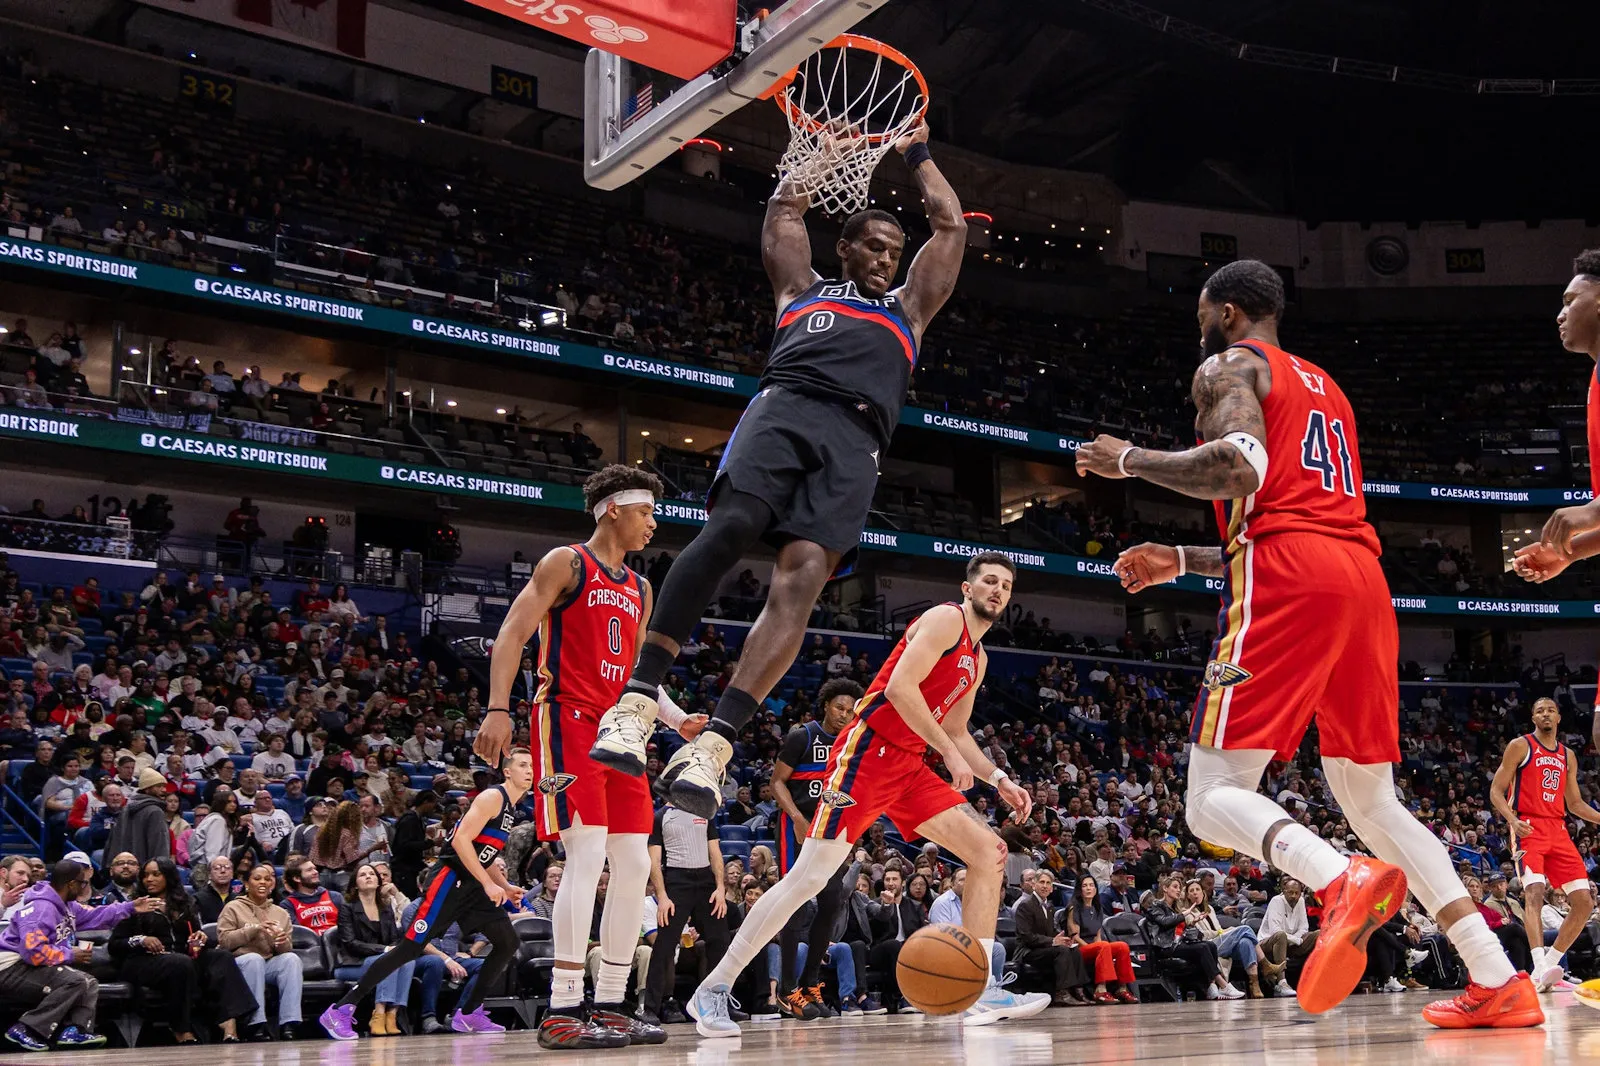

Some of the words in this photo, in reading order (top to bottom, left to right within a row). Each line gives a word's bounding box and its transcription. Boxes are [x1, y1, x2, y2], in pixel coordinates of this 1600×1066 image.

[182, 75, 233, 106] 332
[496, 72, 532, 99] 301
[160, 203, 185, 219] 331
[47, 250, 138, 280] SPORTSBOOK
[1450, 252, 1482, 268] 304
[210, 281, 283, 306] CAESARS
[284, 295, 364, 322] SPORTSBOOK
[807, 310, 835, 333] 0
[426, 321, 489, 344] CAESARS
[491, 333, 561, 357] SPORTSBOOK
[615, 356, 672, 378] CAESARS
[673, 367, 735, 389] SPORTSBOOK
[933, 415, 978, 433] CAESARS
[979, 423, 1029, 442] SPORTSBOOK
[158, 434, 238, 459] CAESARS
[240, 446, 328, 471] SPORTSBOOK
[1301, 409, 1357, 498] 41
[396, 467, 465, 489] CAESARS
[467, 479, 543, 500] SPORTSBOOK
[1439, 487, 1481, 500] CAESARS
[1481, 489, 1529, 502] SPORTSBOOK
[335, 513, 351, 527] 124
[587, 588, 641, 624] CRESCENT
[1467, 601, 1510, 613] CAESARS
[1510, 602, 1560, 614] SPORTSBOOK
[608, 615, 622, 656] 0
[600, 659, 627, 682] CITY
[1535, 755, 1566, 772] CRESCENT
[808, 779, 823, 797] 9
[1541, 767, 1561, 791] 25
[1542, 791, 1556, 803] CITY
[260, 818, 285, 830] NOLA
[268, 827, 285, 839] 25
